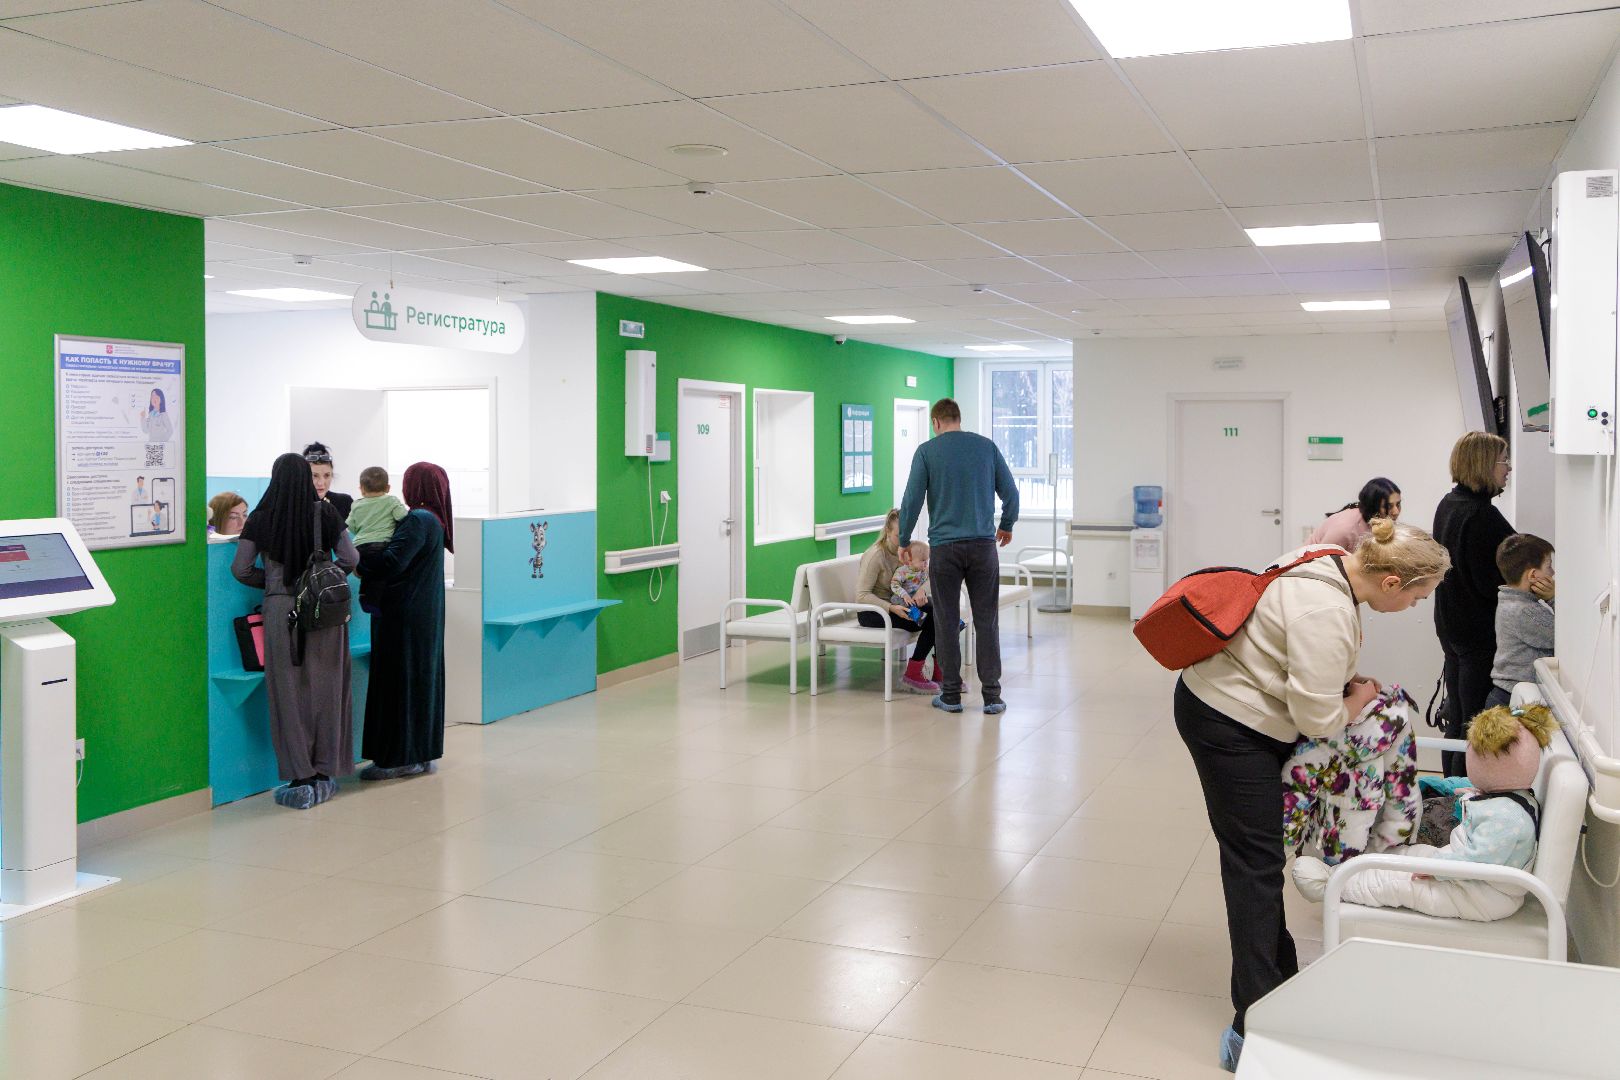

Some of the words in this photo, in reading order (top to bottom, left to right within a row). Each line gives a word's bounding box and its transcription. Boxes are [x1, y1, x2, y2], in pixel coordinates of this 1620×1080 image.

[406, 306, 506, 336] Регистратура
[80, 357, 112, 365] ПОПАСТЬ
[119, 359, 151, 367] НУЖНОМУ
[151, 360, 175, 368] ВРАЧУ?
[697, 424, 710, 434] 109
[1223, 427, 1238, 437] 111
